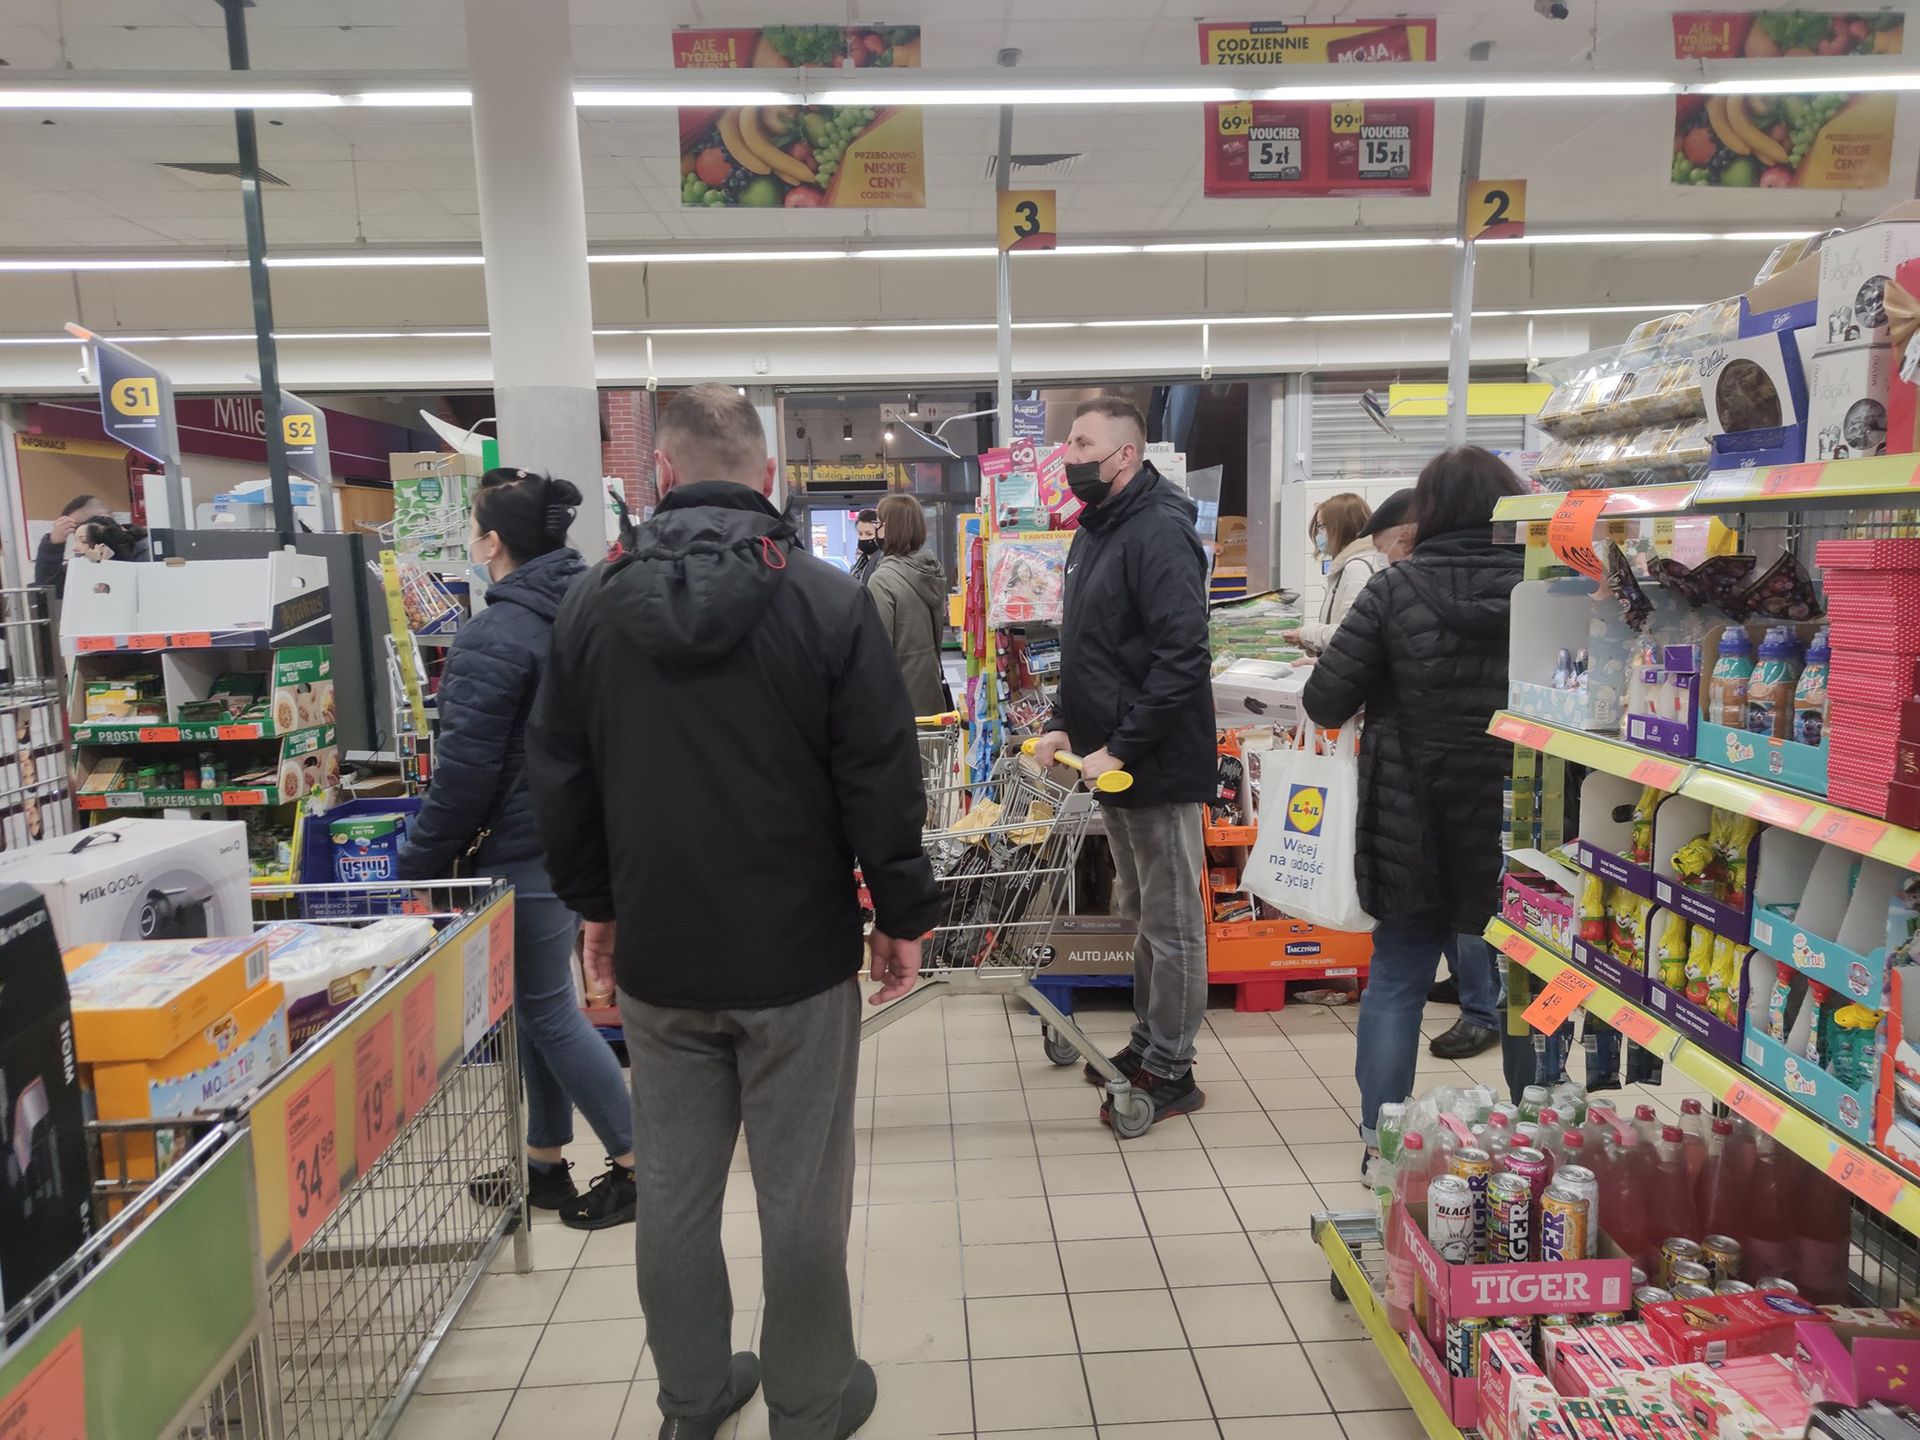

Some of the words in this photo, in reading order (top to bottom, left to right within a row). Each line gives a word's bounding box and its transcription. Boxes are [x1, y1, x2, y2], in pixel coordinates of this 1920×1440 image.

[1217, 37, 1310, 51] CODZIENNIE
[1337, 42, 1390, 63] MOJA
[1217, 52, 1283, 65] ZYSKUJE
[1222, 116, 1242, 129] 69
[1334, 114, 1353, 128] 99
[1249, 127, 1300, 139] VOUCHER
[1360, 126, 1409, 138] VOUCHER
[1260, 142, 1273, 165] 5
[1275, 146, 1290, 164] zł
[1366, 141, 1388, 163] 15
[1390, 145, 1404, 163] zł
[864, 162, 907, 174] NISKIE
[869, 177, 904, 188] CENY
[1483, 190, 1510, 226] 2
[1013, 200, 1040, 237] 3
[123, 386, 151, 408] S1
[213, 398, 267, 436] Mille
[287, 421, 312, 439] S2
[98, 731, 140, 742] PROSTY
[149, 794, 196, 806] PRZEPIS
[1283, 836, 1319, 860] Więcej
[341, 859, 389, 879] finish
[1269, 853, 1287, 866] na
[1274, 871, 1283, 882] z
[79, 885, 107, 905] Milk
[1068, 950, 1101, 961] AUTO
[1102, 950, 1124, 961] JAK
[362, 1081, 383, 1142] 19
[296, 1143, 322, 1218] 34
[1438, 1205, 1472, 1215] BLACK
[1509, 1201, 1531, 1262] GER
[1542, 1210, 1565, 1262] GER
[1471, 1273, 1591, 1305] TIGER
